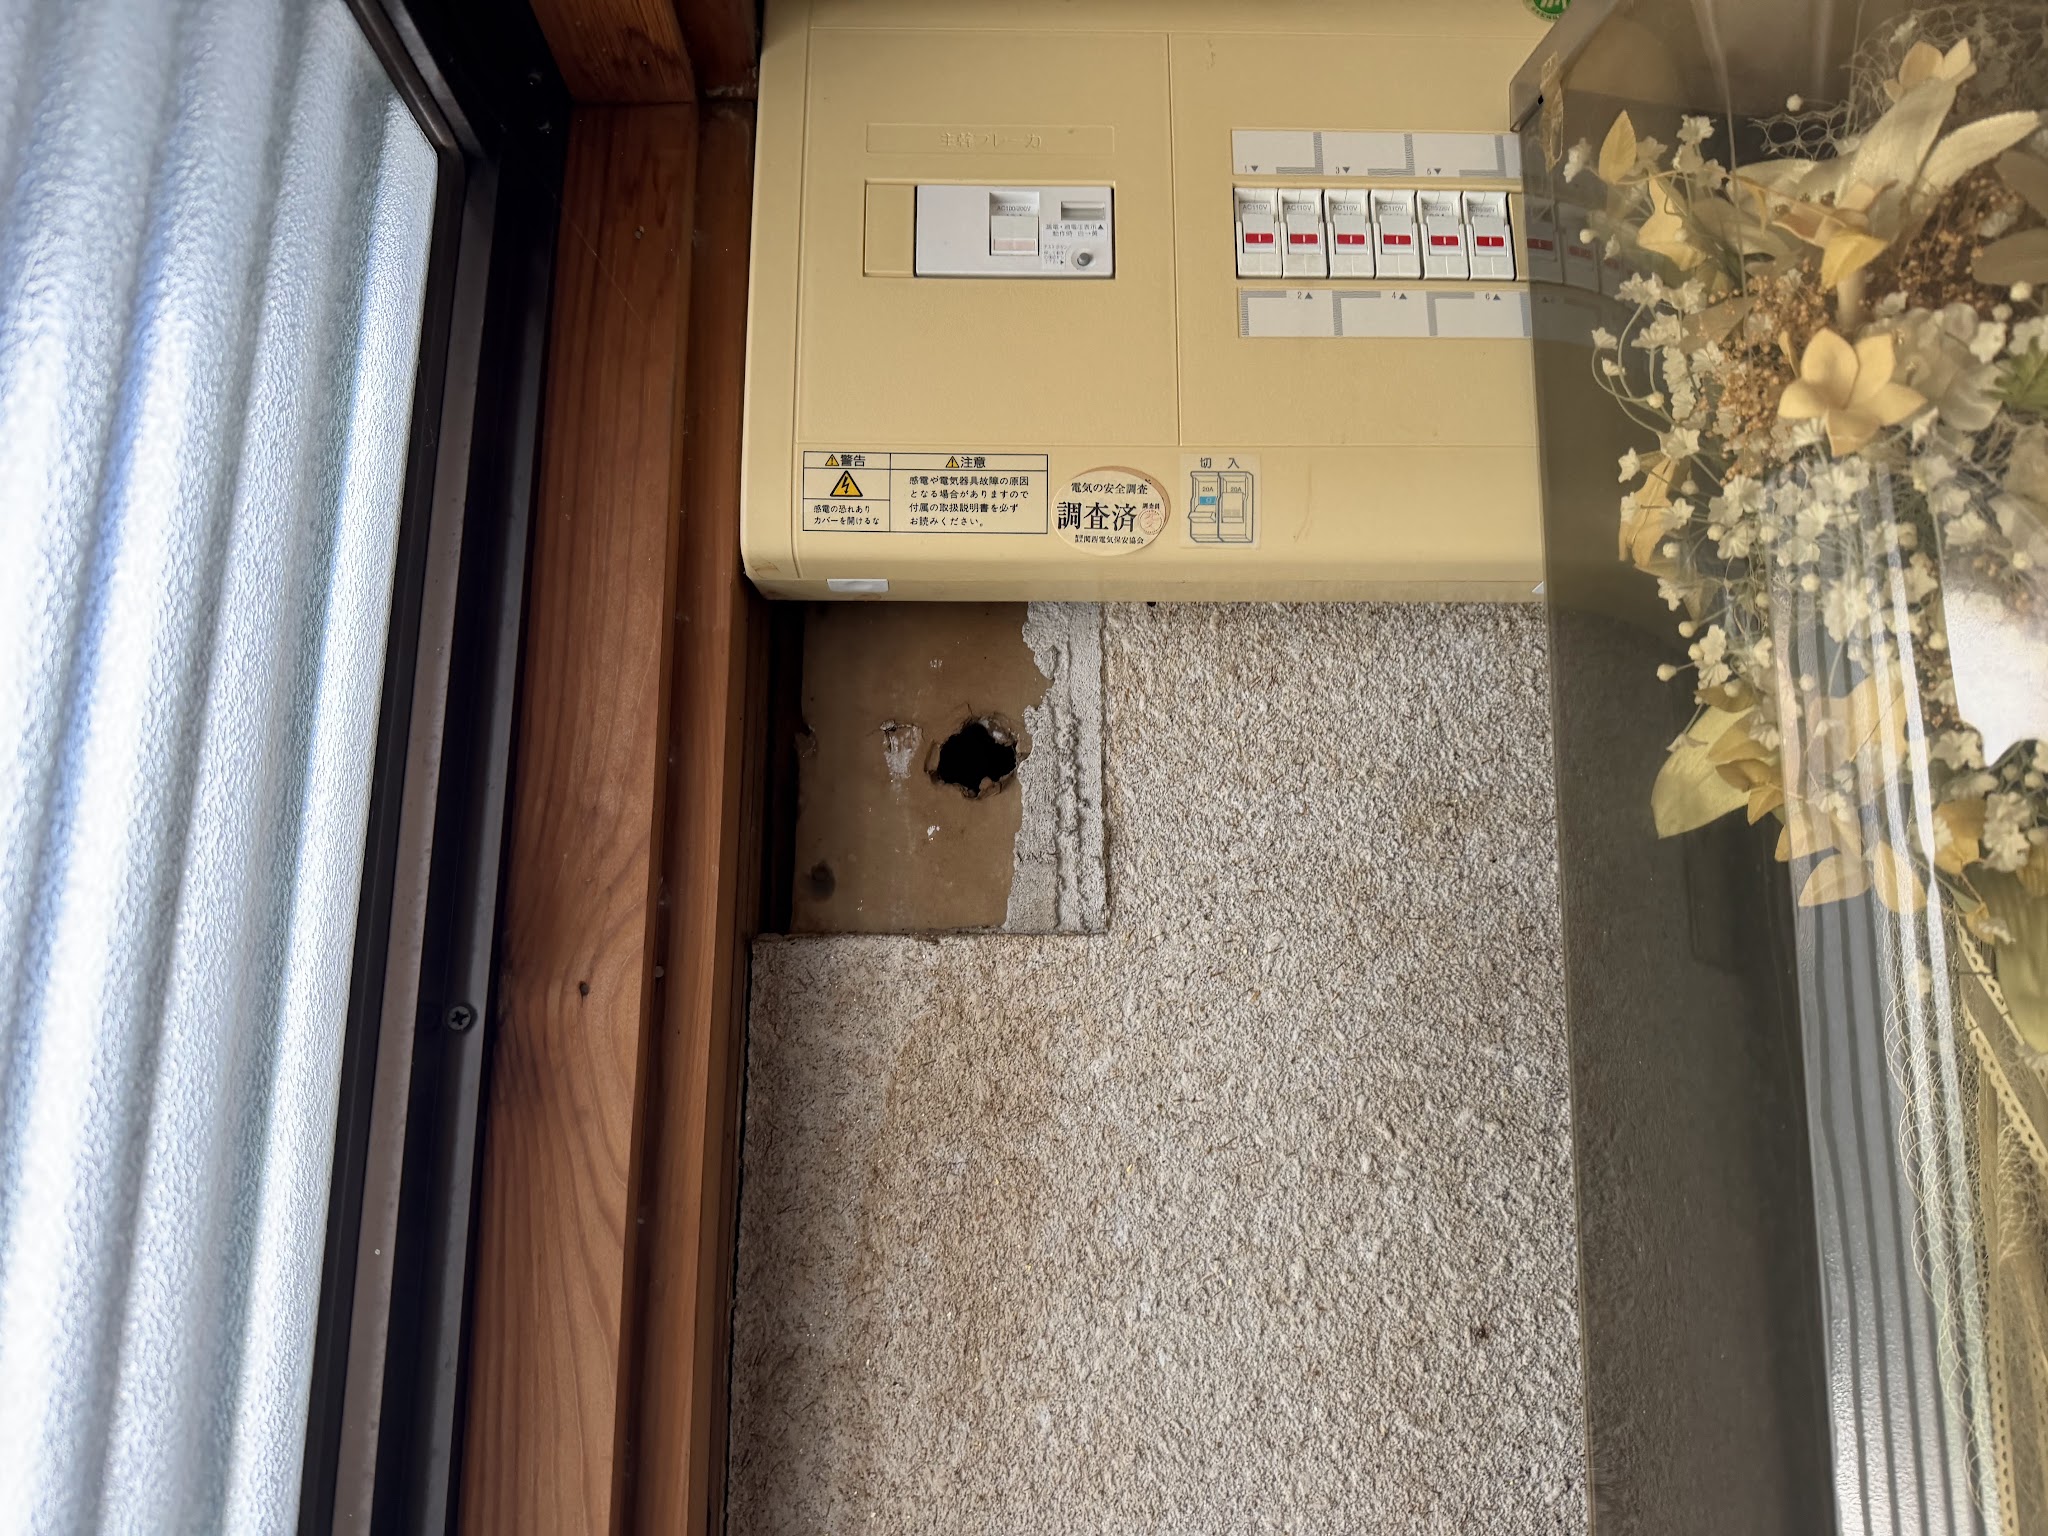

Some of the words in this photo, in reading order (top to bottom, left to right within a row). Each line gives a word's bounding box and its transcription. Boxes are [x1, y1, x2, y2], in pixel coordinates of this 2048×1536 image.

[840, 454, 866, 467] 警告
[960, 456, 986, 468] 注意
[1200, 457, 1212, 469] 切
[1228, 458, 1240, 469] 入
[909, 475, 1029, 487] 感電や電気器具故障の原因
[909, 489, 1029, 499] となる場合がありますので
[1070, 482, 1148, 495] 電気の安全調査
[813, 505, 871, 514] 感電の恐れあり
[909, 502, 1019, 513] 付属の取扱説明書を必ず
[813, 517, 880, 526] カバーを開けるな
[909, 516, 985, 527] お読みください。
[1056, 501, 1137, 533] 調査済
